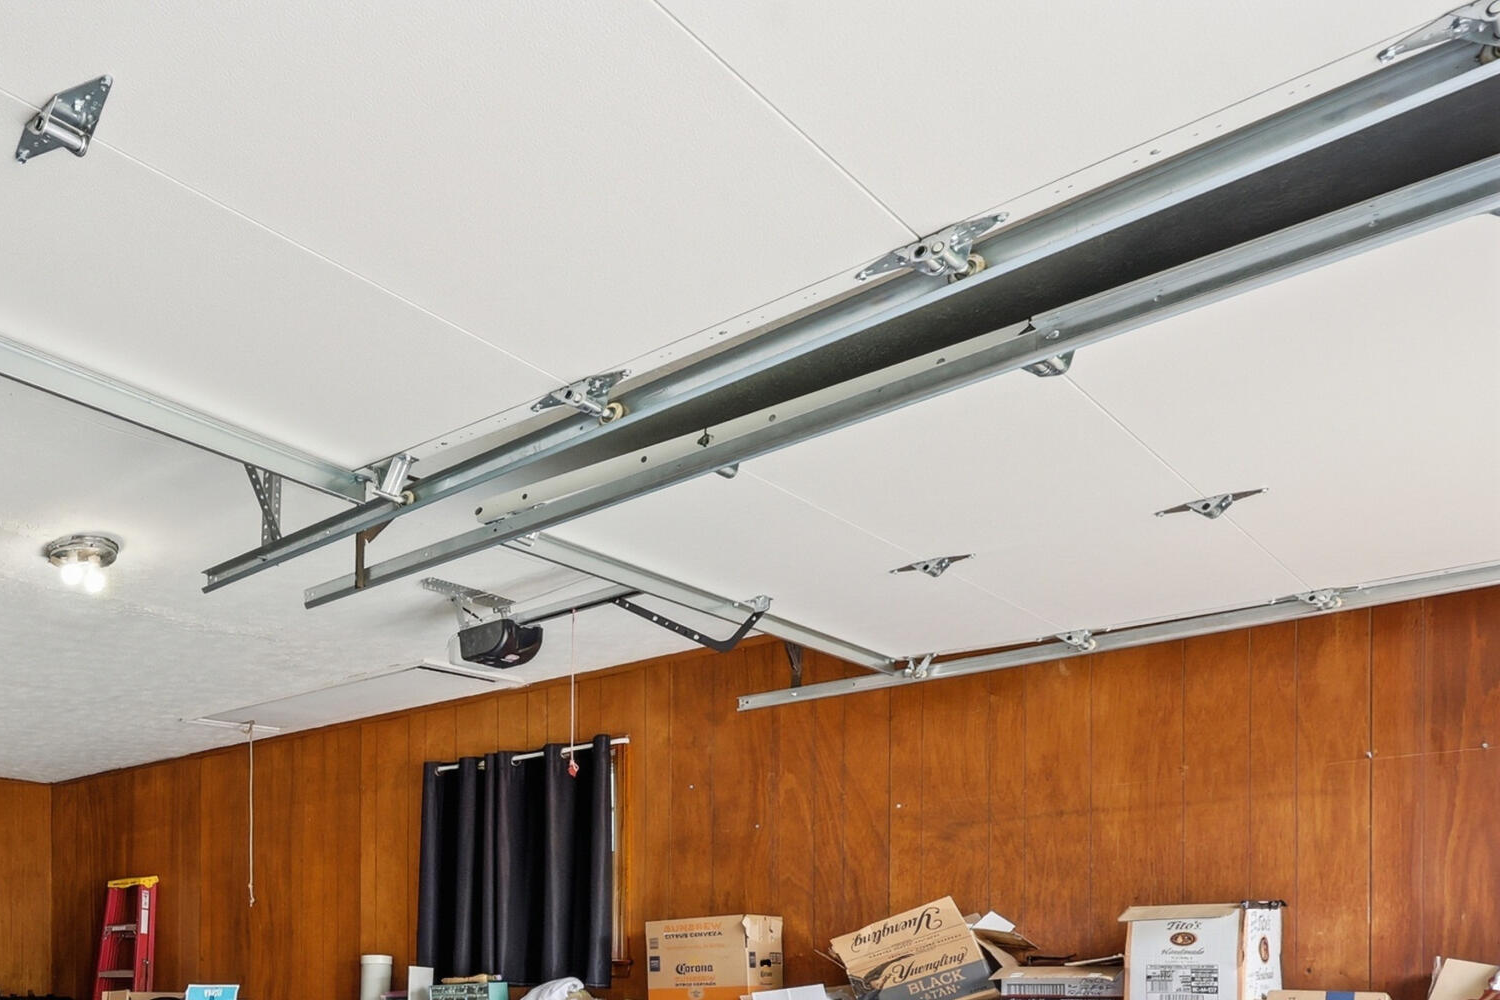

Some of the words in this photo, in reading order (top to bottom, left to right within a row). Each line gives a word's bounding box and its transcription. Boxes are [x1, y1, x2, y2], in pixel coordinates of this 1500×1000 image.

[675, 962, 714, 975] Corona
[891, 945, 969, 984] Yuengling
[907, 968, 967, 995] BLACK
